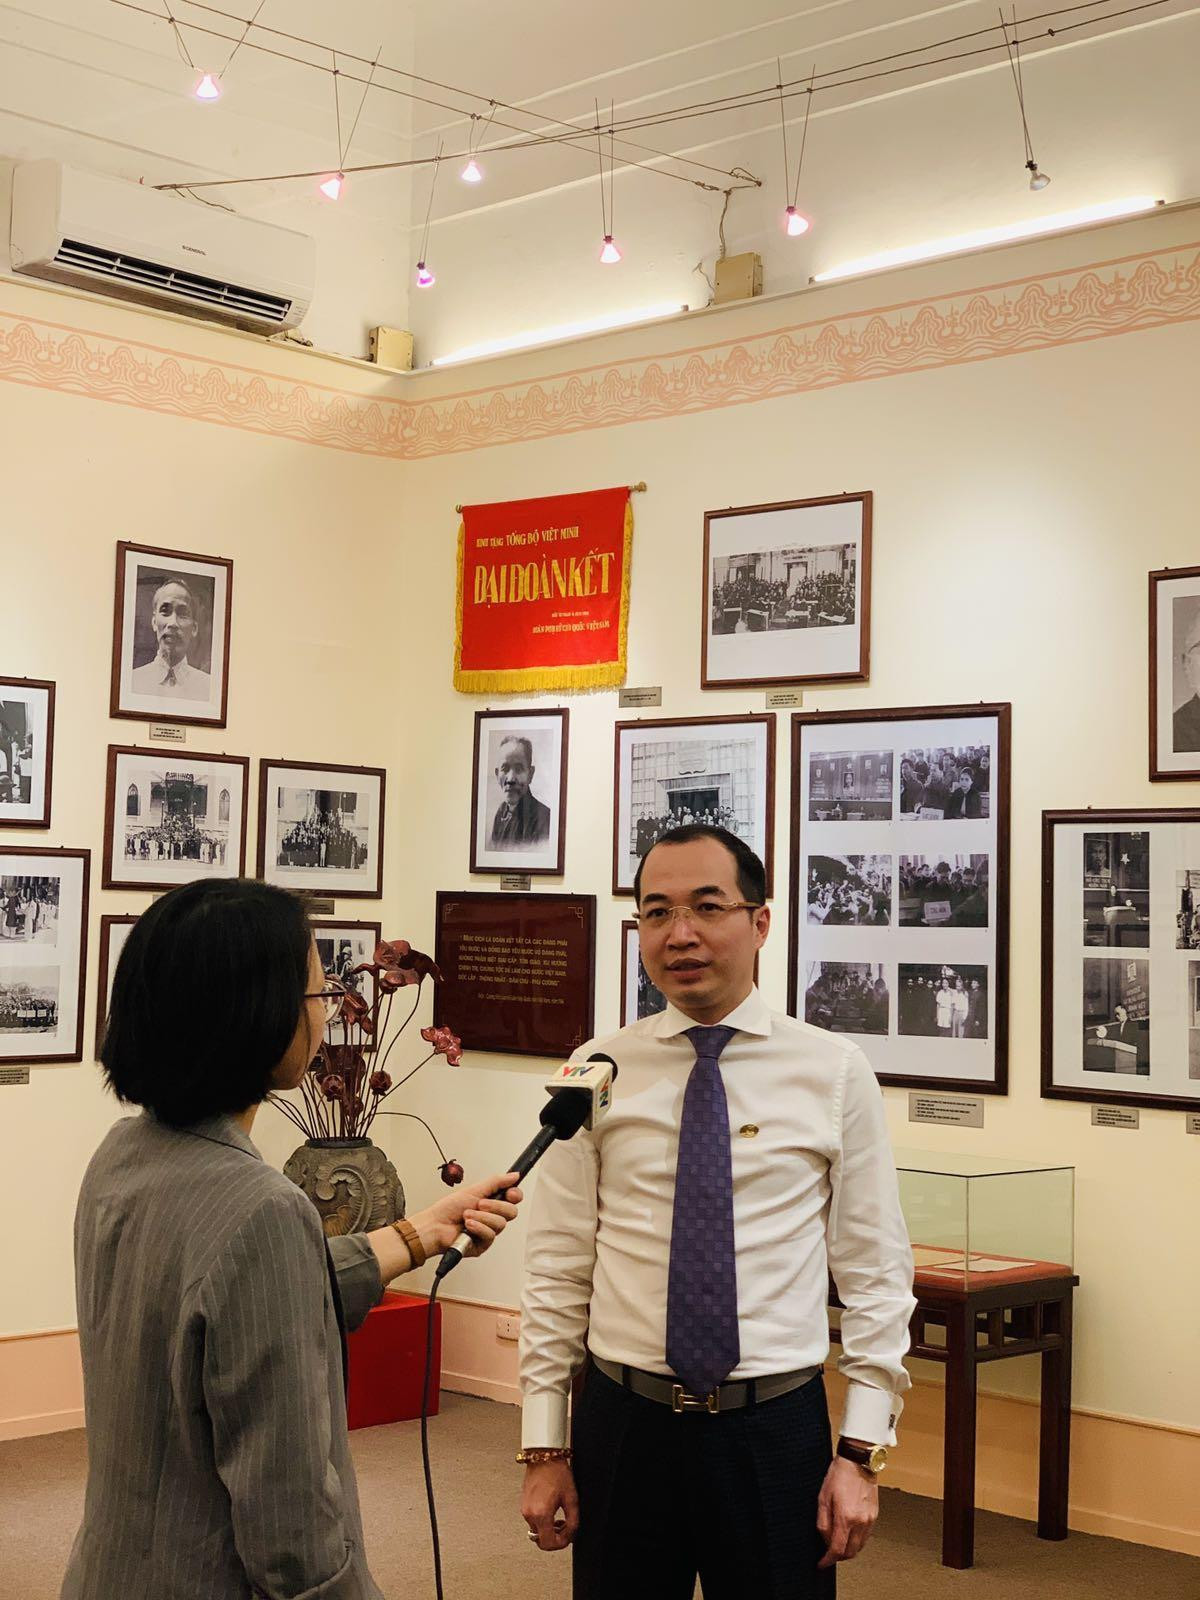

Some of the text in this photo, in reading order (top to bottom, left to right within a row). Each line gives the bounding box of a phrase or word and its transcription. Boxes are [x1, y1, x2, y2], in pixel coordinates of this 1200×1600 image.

[528, 529, 540, 546] BỘ
[542, 526, 559, 543] VIỆT
[560, 526, 579, 540] MINH
